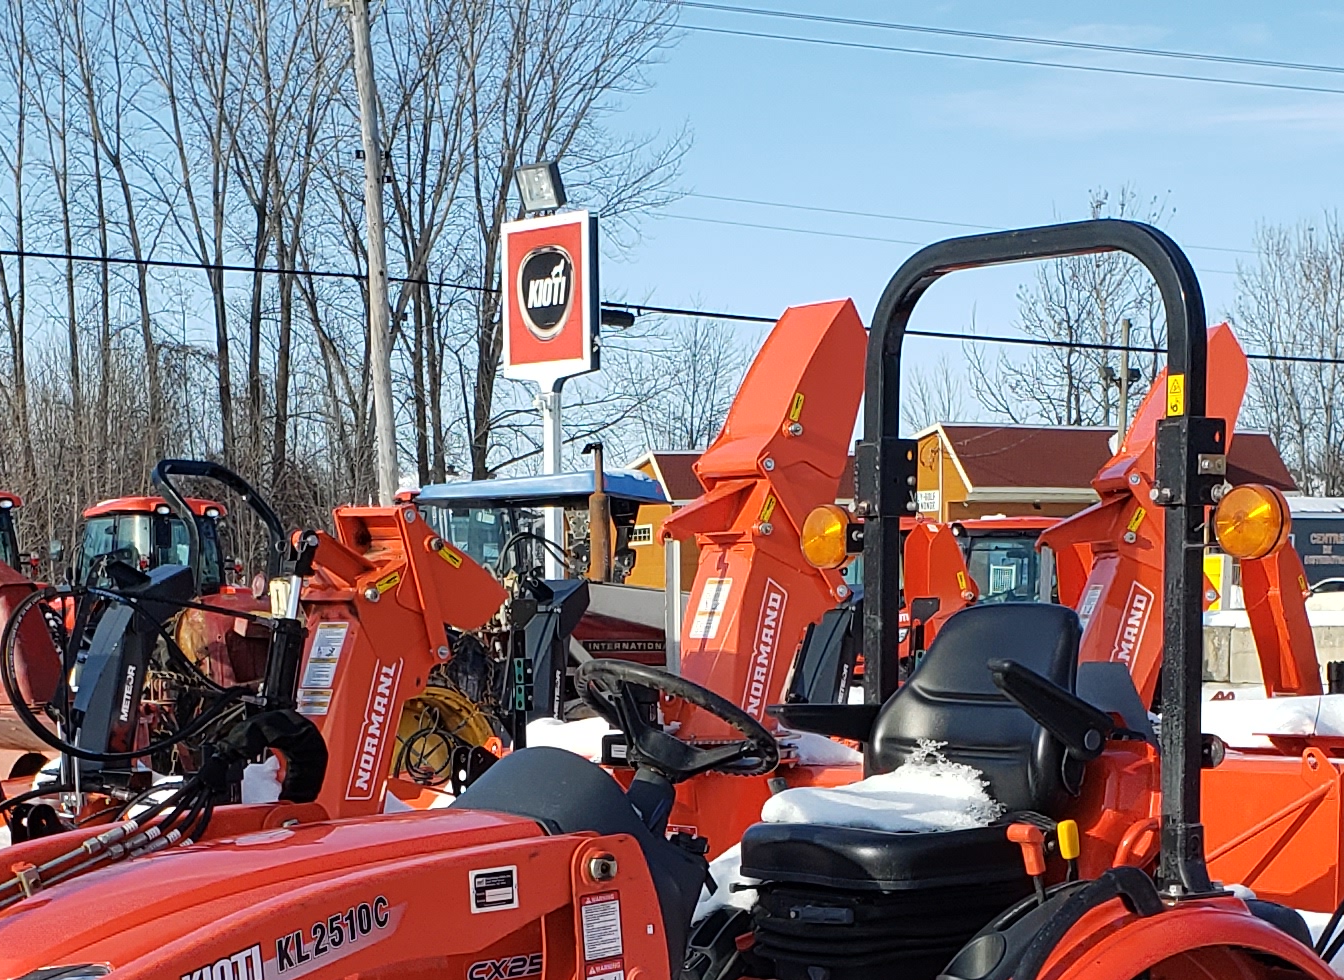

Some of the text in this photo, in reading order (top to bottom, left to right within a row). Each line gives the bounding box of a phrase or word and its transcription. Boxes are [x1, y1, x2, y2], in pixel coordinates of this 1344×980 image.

[527, 275, 567, 309] KIOTI
[746, 592, 782, 716] NORMAND
[1117, 594, 1147, 663] MAND
[119, 665, 137, 722] METEOR
[596, 962, 621, 973] WARNING
